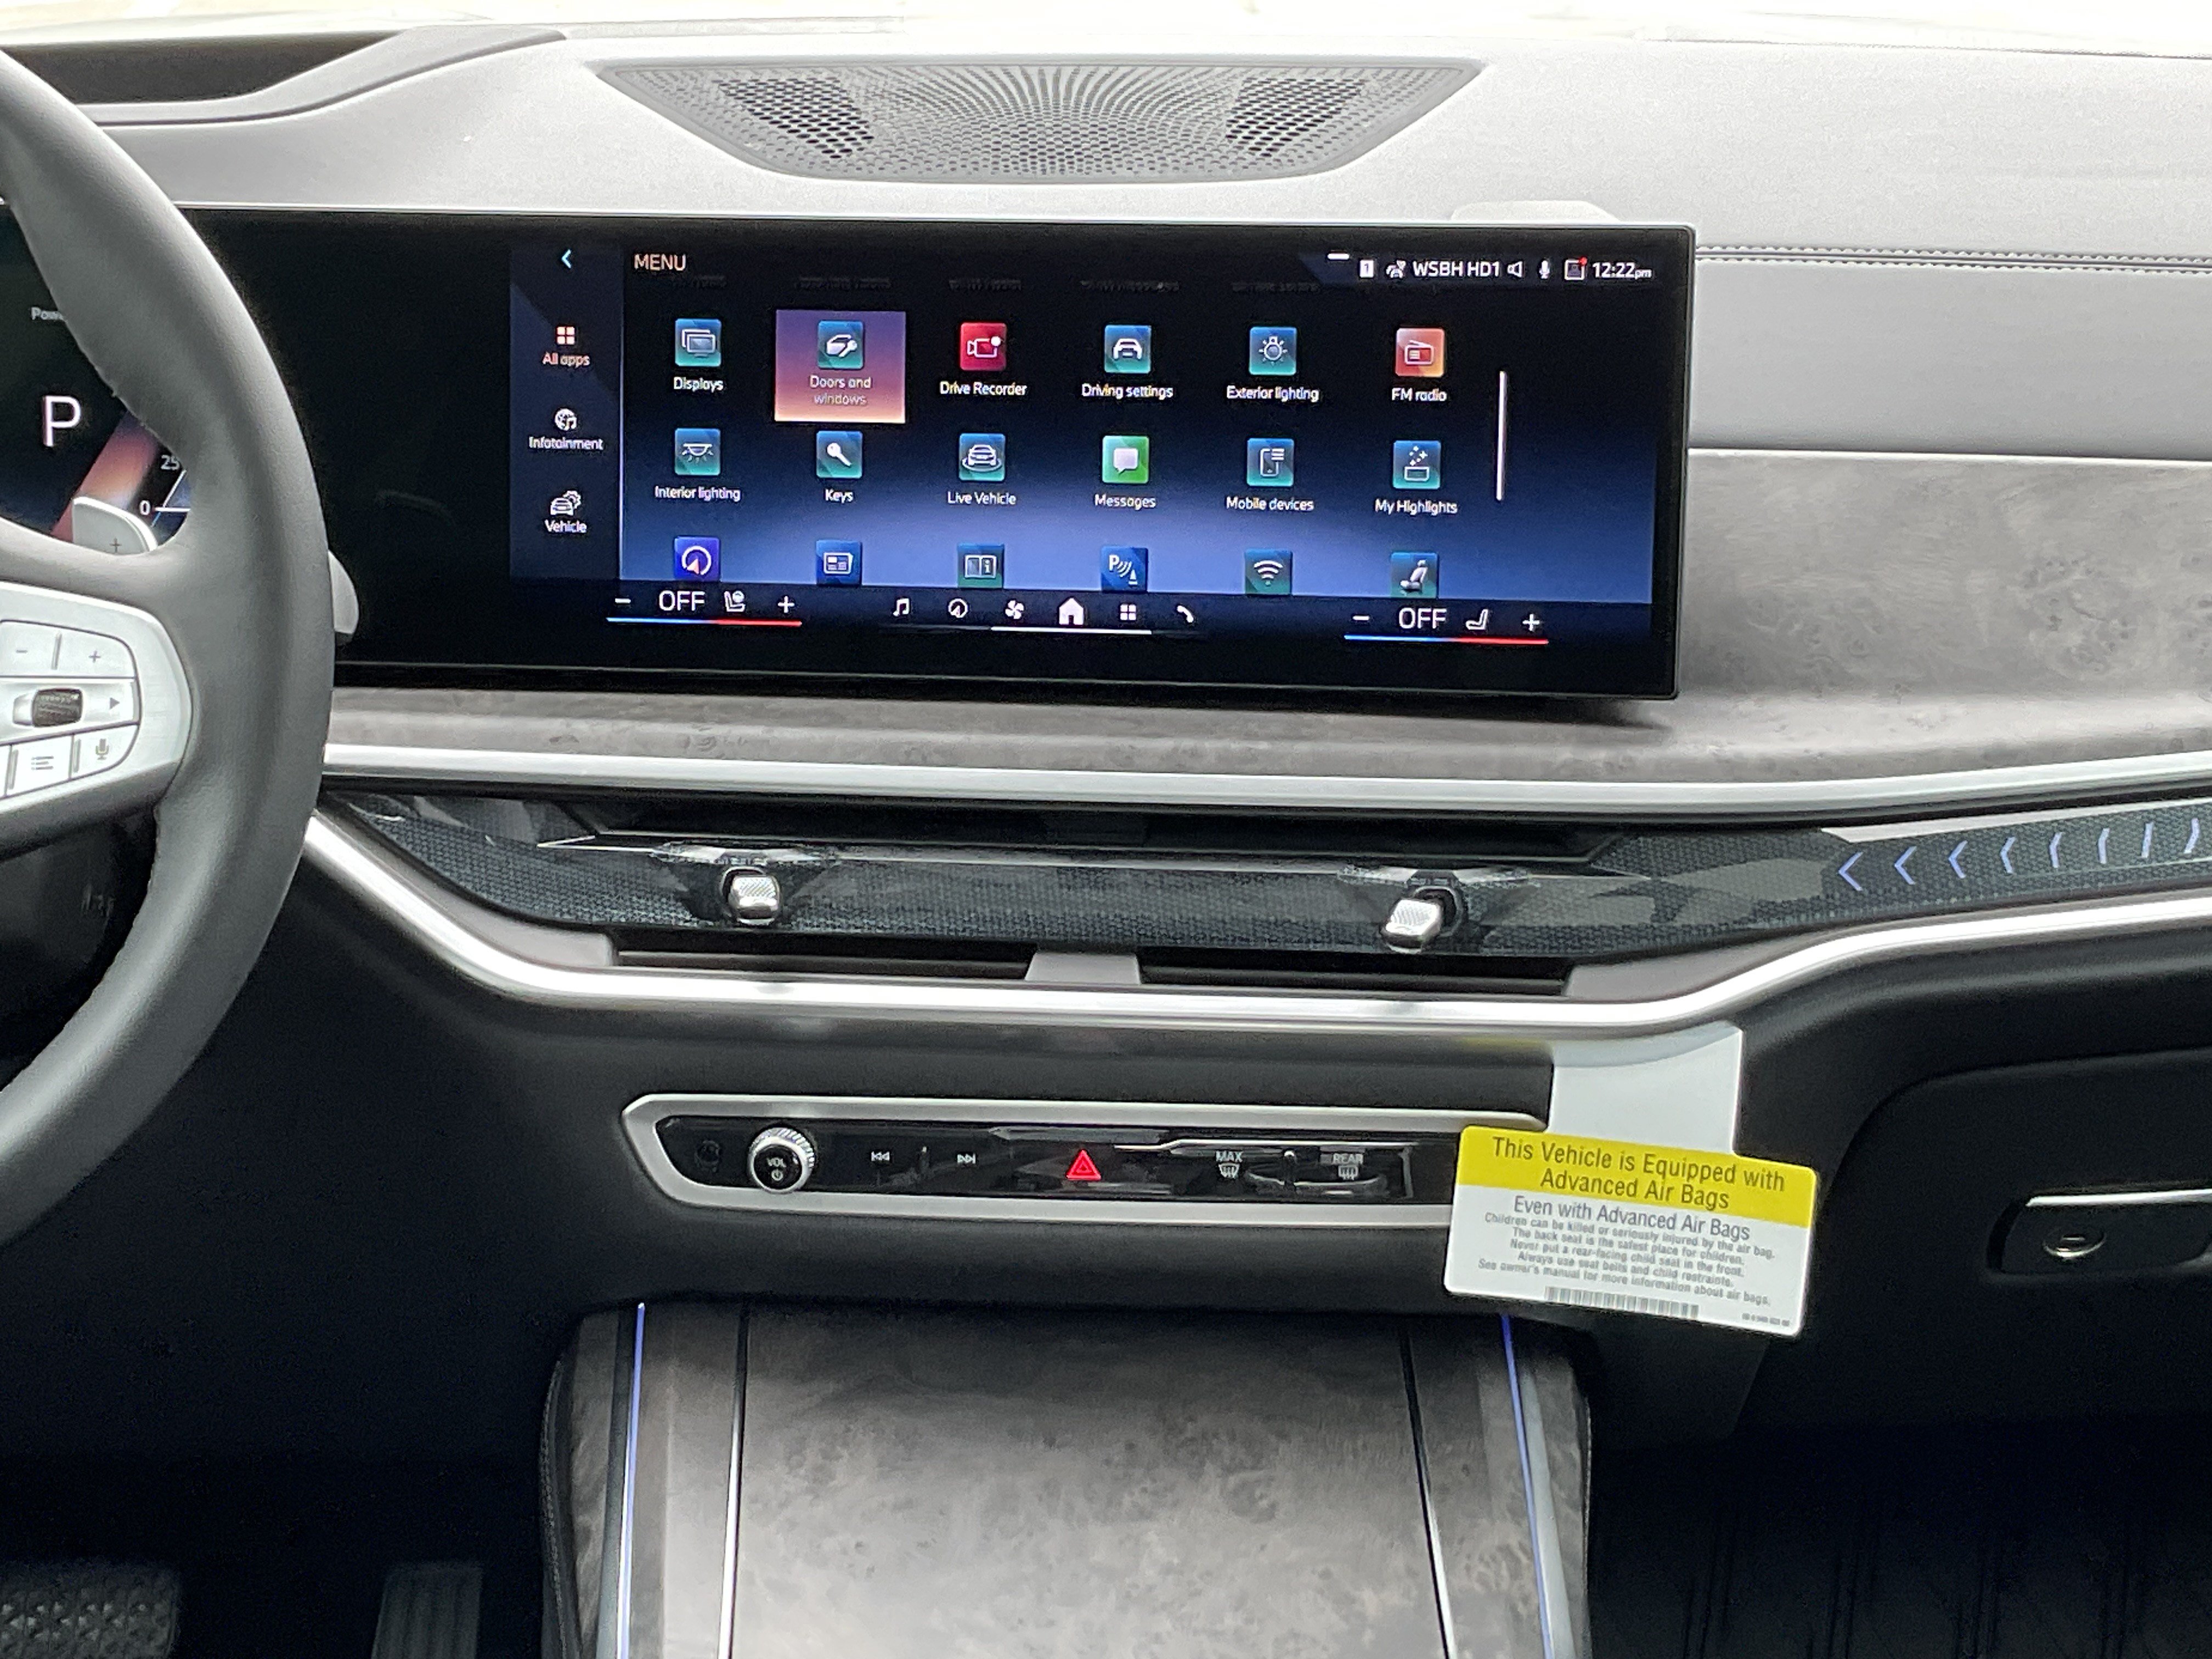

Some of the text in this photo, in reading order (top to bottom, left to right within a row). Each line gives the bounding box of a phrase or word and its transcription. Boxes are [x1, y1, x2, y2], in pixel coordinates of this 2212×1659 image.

[634, 253, 687, 271] MENU
[1413, 261, 1499, 277] WSBH HD1
[542, 352, 590, 368] All apps
[674, 377, 724, 393] Displays
[810, 375, 871, 390] Doors and
[940, 381, 1027, 397] Drive Recorder
[814, 392, 867, 405] windows
[1081, 383, 1173, 400] Driving settings
[1226, 385, 1319, 403] Exterior lighting
[1392, 388, 1447, 402] FM radio
[41, 395, 82, 448] P
[529, 436, 603, 450] Infotainment
[161, 455, 180, 470] 25
[655, 486, 741, 502] Interior lighting
[825, 489, 854, 503] Keys
[947, 492, 1017, 506] Live Vehicle
[1094, 494, 1156, 510] Messages
[139, 500, 151, 515] 0
[1226, 496, 1314, 512] Mobile devices
[1375, 499, 1458, 516] My Highlights
[545, 520, 587, 534] Vehicle
[659, 591, 705, 611] OFF
[1398, 608, 1447, 629] OFF
[766, 1157, 787, 1167] VOL
[1215, 1151, 1243, 1163] MAX
[1333, 1153, 1364, 1165] REAR
[1493, 1136, 1785, 1192] This Vehicle is Equipped with
[1541, 1167, 1730, 1211] Advanced Air Bags
[1514, 1195, 1750, 1243] Even with Advanced Air Bags
[1485, 1212, 1775, 1260] Children can be killed or seriously injured by the air bag.
[1513, 1227, 1531, 1238] The
[1534, 1229, 1557, 1241] back
[1561, 1233, 1582, 1244] seat
[1598, 1237, 1614, 1248] the
[1618, 1239, 1649, 1251] safest
[1651, 1243, 1679, 1256] place
[1681, 1246, 1696, 1257] for
[1700, 1248, 1745, 1265] children.
[1510, 1238, 1538, 1250] Never
[1542, 1242, 1559, 1254] put
[1572, 1246, 1628, 1262] rear-facing
[1630, 1252, 1656, 1265] child
[1658, 1257, 1680, 1268] seat
[1684, 1260, 1693, 1269] in
[1697, 1261, 1713, 1272] the
[1716, 1263, 1745, 1278] front.
[1517, 1251, 1554, 1265] Always
[1602, 1261, 1628, 1273] belts
[1630, 1265, 1650, 1275] and
[1652, 1267, 1678, 1279] child
[1478, 1257, 1770, 1306] See owner's manual for more information about air bags.
